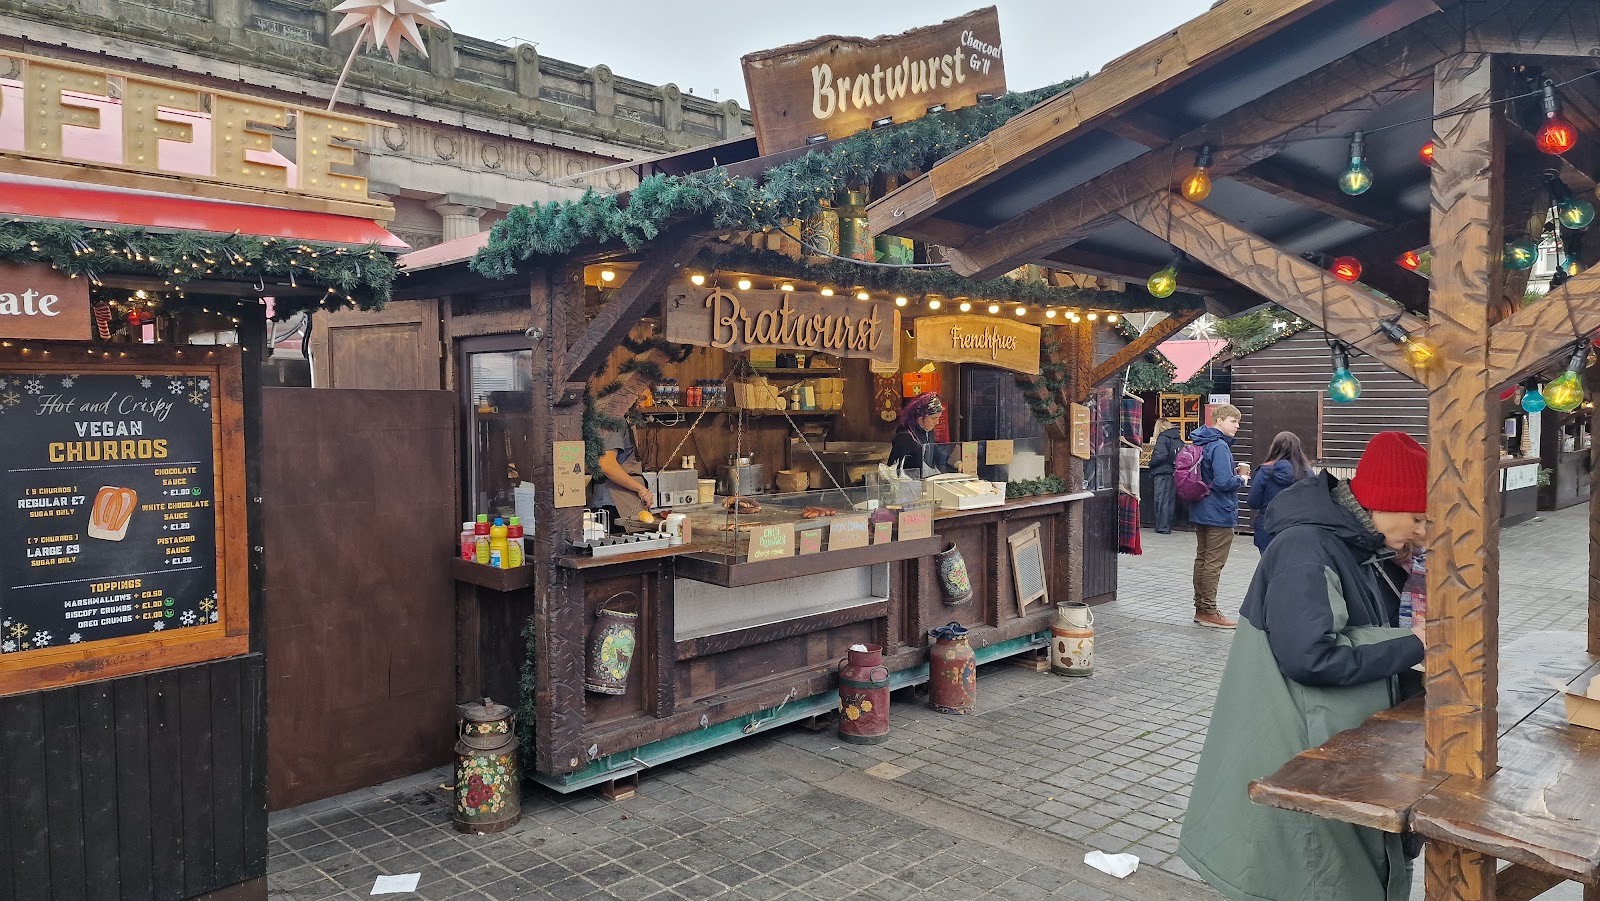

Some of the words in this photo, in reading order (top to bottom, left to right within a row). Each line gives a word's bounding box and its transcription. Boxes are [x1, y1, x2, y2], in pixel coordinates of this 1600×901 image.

[961, 29, 1002, 60] Charcoal
[811, 46, 966, 119] Bratwurst
[0, 57, 369, 200] FFEE
[0, 288, 61, 317] ate
[706, 287, 883, 351] Bratwurst
[36, 394, 76, 416] Hot
[79, 392, 118, 415] and
[118, 394, 174, 422] Crispy
[74, 421, 143, 437] VEGAN
[49, 439, 168, 463] CHURROS
[154, 467, 197, 476] CHOCOLATE
[162, 478, 187, 486] SAUCE
[170, 488, 190, 496] £1.00
[17, 497, 67, 508] REGULAR
[71, 495, 85, 506] £7
[141, 503, 166, 512] WHITE
[167, 500, 209, 510] CHOCOLATE
[163, 512, 189, 521] SAUCE
[170, 522, 190, 531] £1.20
[40, 535, 73, 543] CHURROS
[157, 535, 196, 545] PISTACHIO
[27, 546, 62, 557] LARGE
[65, 544, 80, 555] £9
[165, 546, 190, 555] SAUCE
[171, 556, 192, 565] £1.20
[90, 579, 142, 593] TOPPINGS
[64, 594, 131, 608] MARSHMALLOWS
[141, 590, 163, 599] £0.50
[65, 608, 98, 620] BISCOFF
[100, 604, 132, 616] CRUMBS
[142, 600, 163, 610] £1.00
[77, 621, 99, 629] OREO
[100, 615, 133, 626] CRUMBS
[142, 611, 163, 621] £1.00
